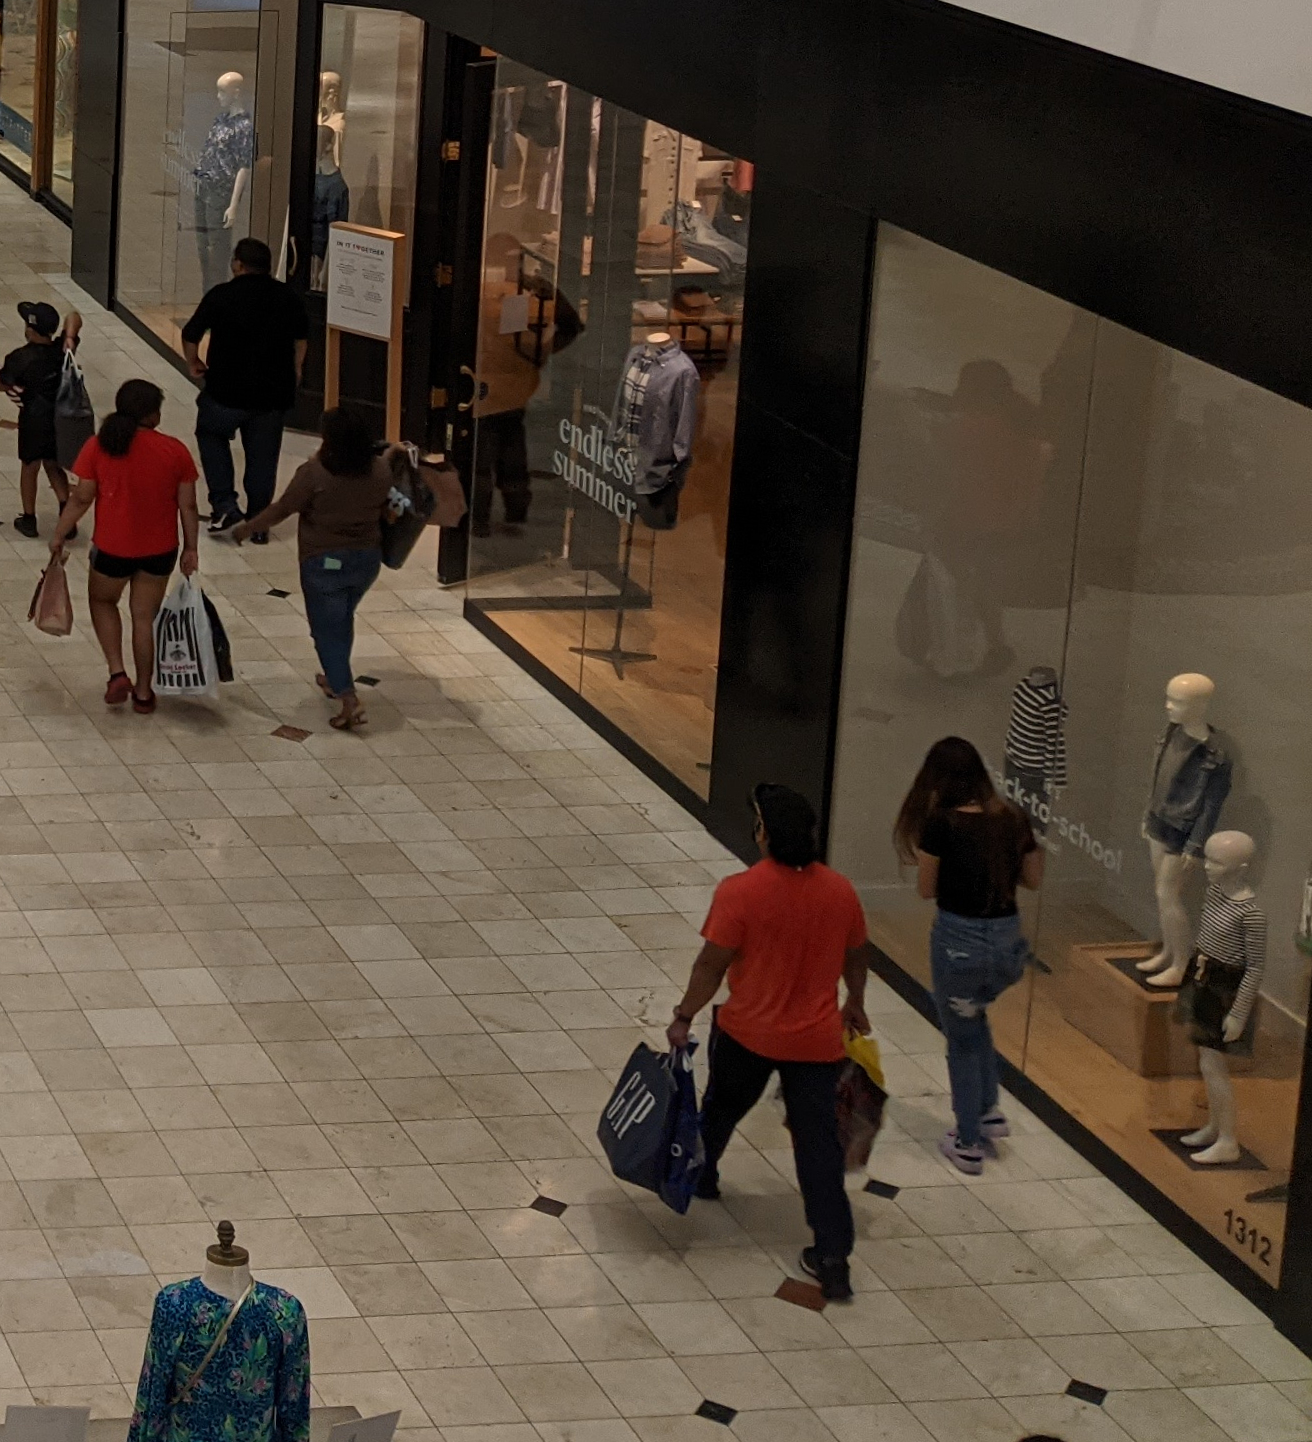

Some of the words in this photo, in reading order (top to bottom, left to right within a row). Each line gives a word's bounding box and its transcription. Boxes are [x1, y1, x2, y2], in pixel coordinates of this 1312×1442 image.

[559, 418, 635, 486] endless
[554, 450, 637, 525] summer
[995, 770, 1123, 874] ack-to-school
[606, 1070, 656, 1140] GAP
[1223, 1208, 1272, 1267] 1312
